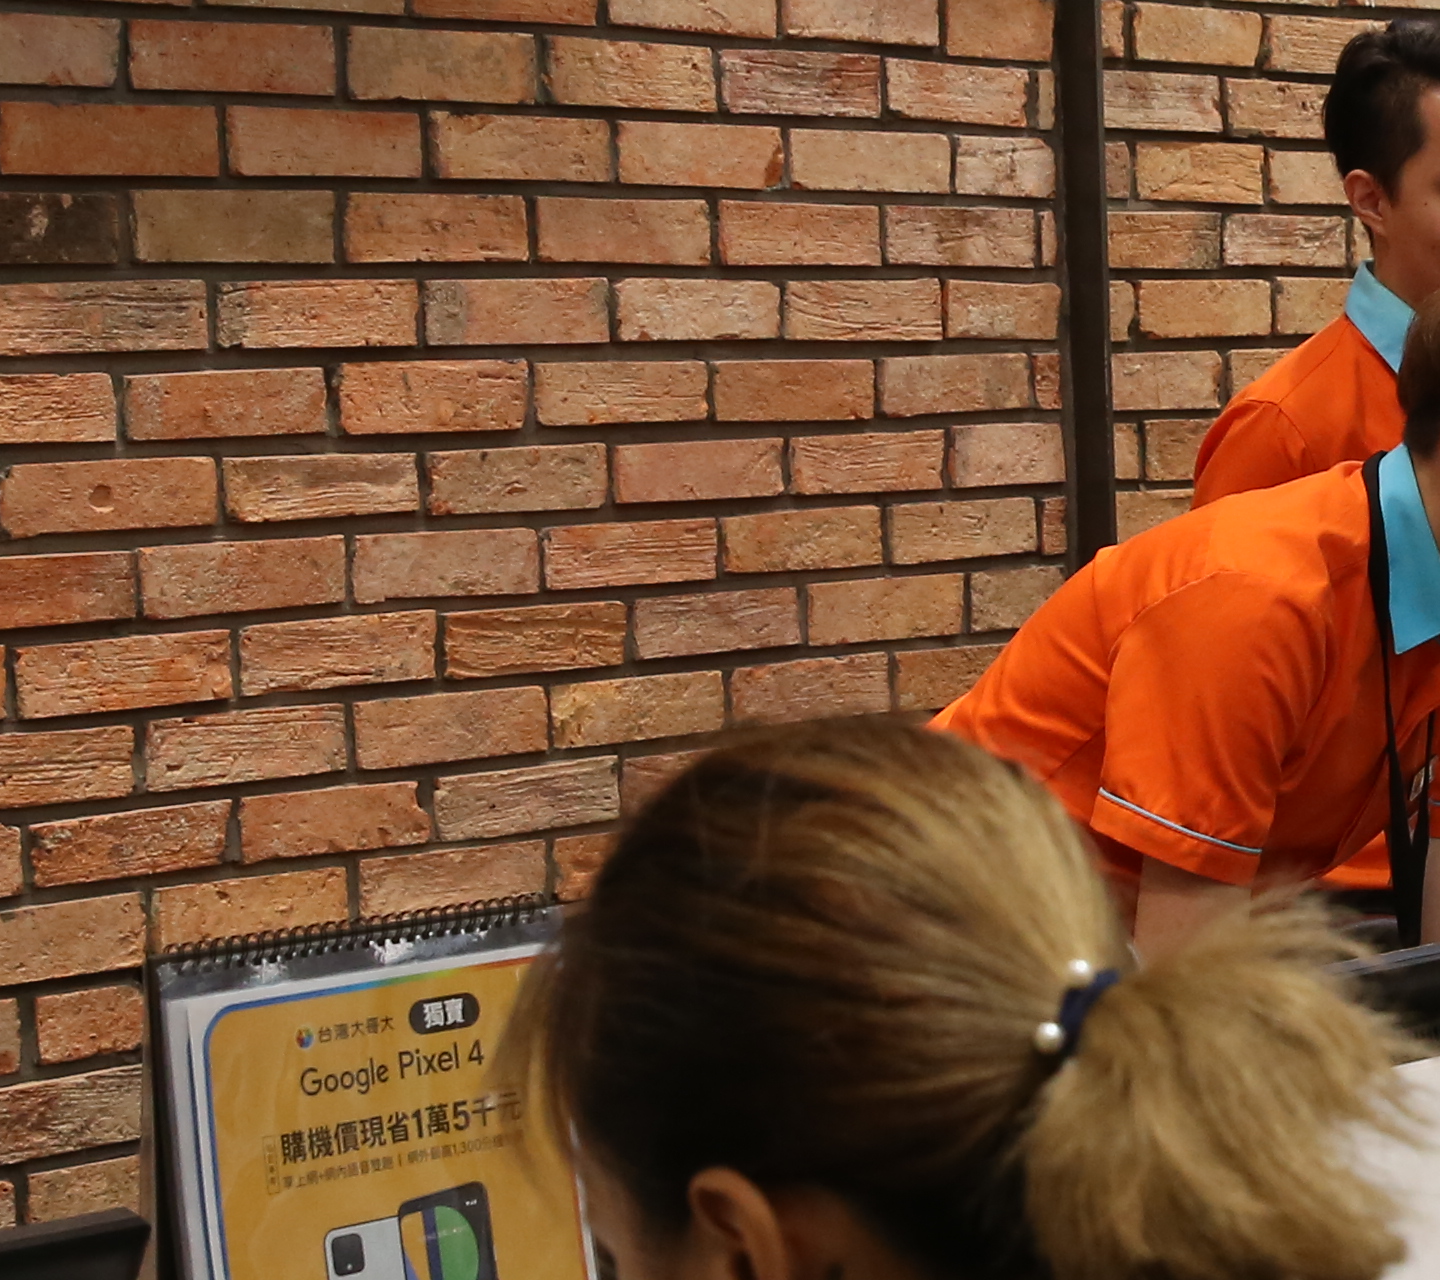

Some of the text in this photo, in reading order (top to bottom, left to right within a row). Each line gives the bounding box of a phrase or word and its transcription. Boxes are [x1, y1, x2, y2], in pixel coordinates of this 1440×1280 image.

[300, 1039, 485, 1097] Google Pixel 4
